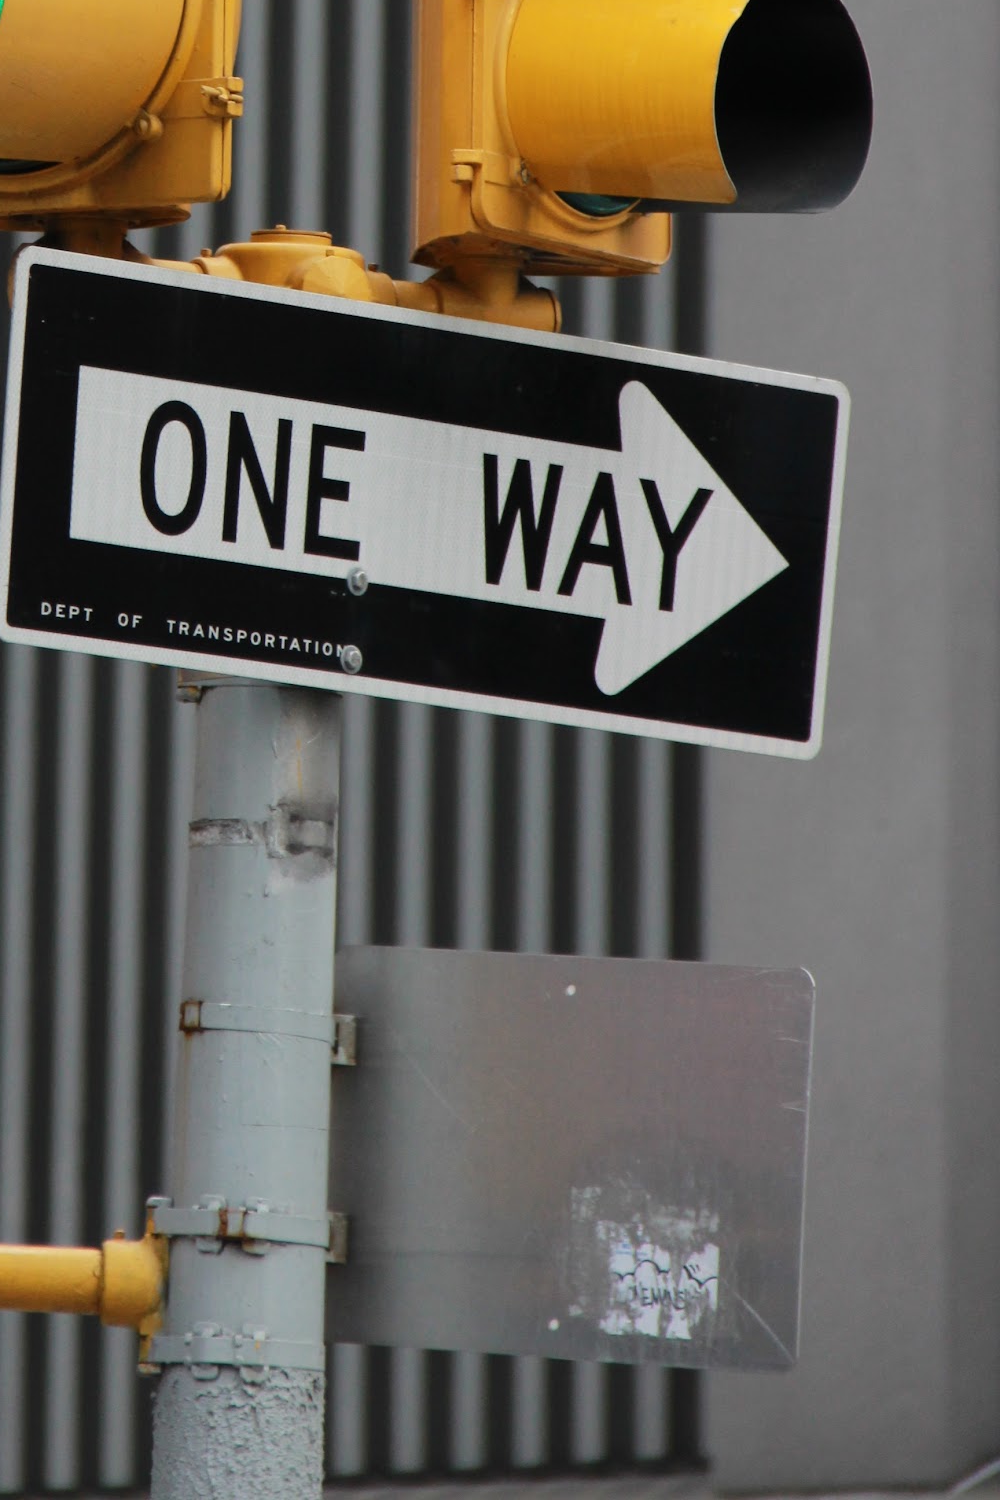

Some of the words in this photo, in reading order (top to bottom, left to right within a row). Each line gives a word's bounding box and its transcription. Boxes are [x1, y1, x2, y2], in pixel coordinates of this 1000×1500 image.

[140, 400, 366, 562] ONE
[482, 453, 714, 612] WAY
[41, 602, 93, 622] DEPT
[118, 613, 143, 628] OF
